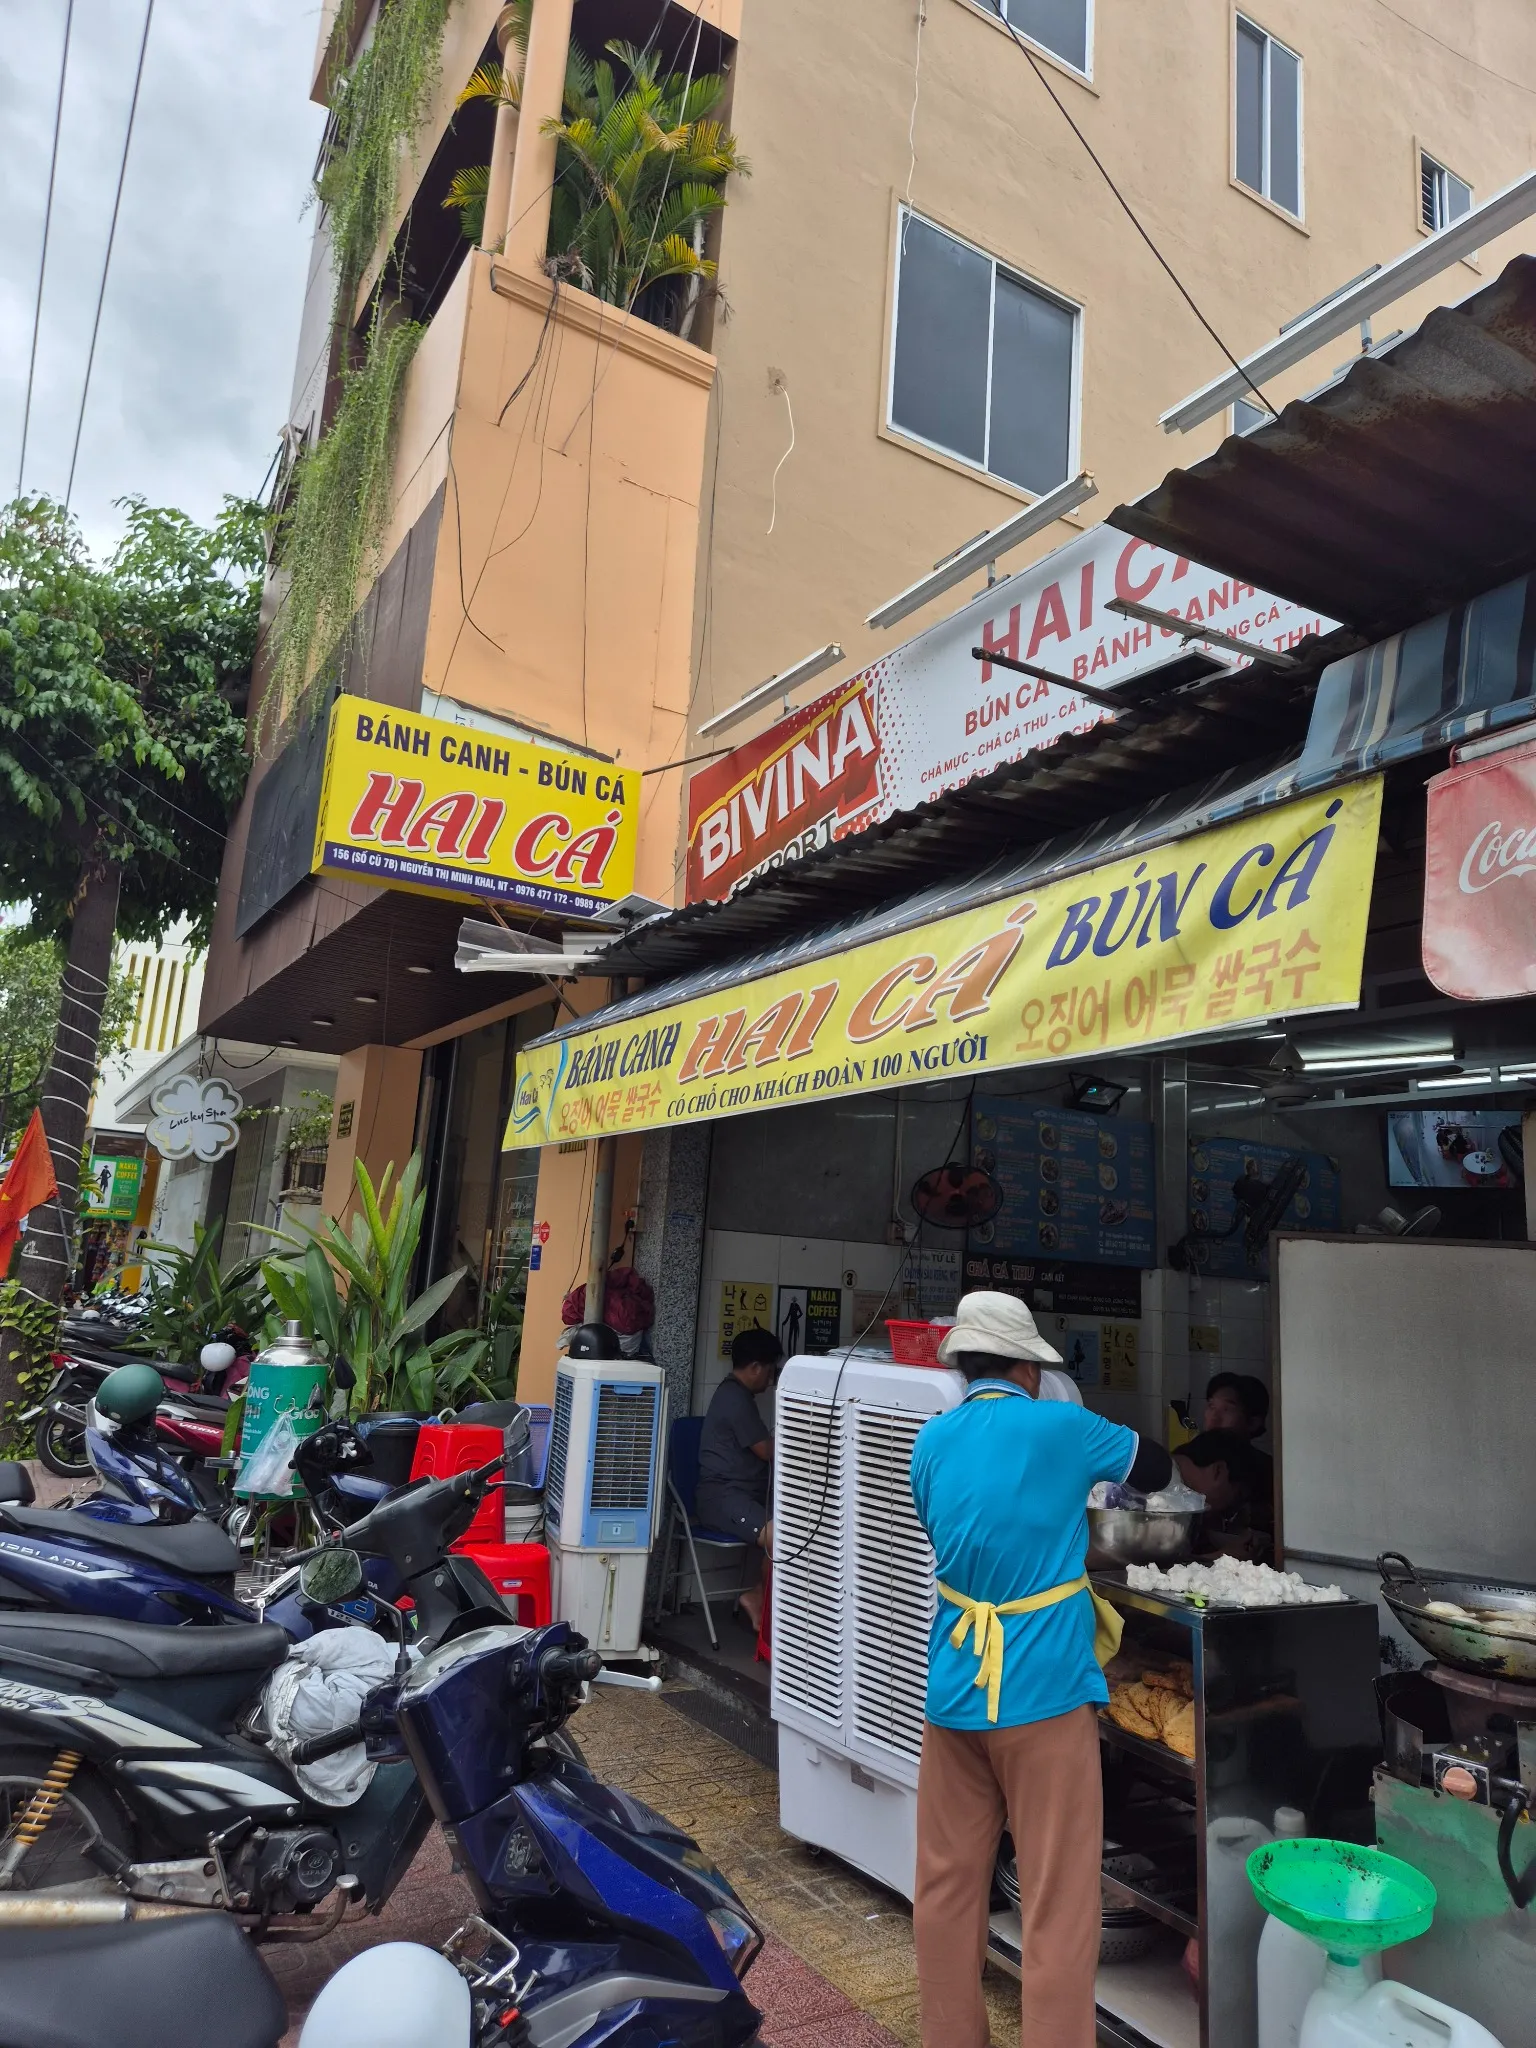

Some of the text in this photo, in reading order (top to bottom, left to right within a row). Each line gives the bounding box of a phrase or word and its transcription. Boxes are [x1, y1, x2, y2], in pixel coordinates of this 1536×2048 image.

[980, 560, 1095, 683] HAI
[921, 761, 942, 783] CHẢ
[944, 751, 969, 772] MỰC
[977, 732, 1002, 756] CHẢ
[1004, 724, 1021, 744] CÁ
[1024, 713, 1049, 735] THU
[1058, 697, 1077, 718] CÁ
[1254, 601, 1281, 628] CÁ
[965, 692, 1011, 736] BÚN
[1073, 622, 1152, 682] BÁNH
[356, 714, 430, 757] BÁNH
[439, 735, 510, 776] CANH
[518, 767, 529, 775] -
[538, 759, 587, 796] BÚN
[595, 774, 626, 805] CÁ
[700, 694, 878, 880] BIVINA
[349, 770, 623, 889] HAI CÁ
[333, 848, 349, 860] 156
[351, 850, 367, 864] (SỐ
[383, 857, 398, 872] 7B)
[400, 861, 433, 877] NGUYỄN
[435, 868, 449, 882] THỊ
[451, 871, 473, 885] MINH
[474, 875, 495, 891] KHAI,
[497, 880, 508, 892] NT
[516, 884, 535, 898] 0976
[536, 889, 551, 900] 477
[554, 892, 567, 904] 172
[575, 896, 594, 909] 0989
[1045, 798, 1344, 970] BÚN CÁ
[678, 900, 1037, 1086] HAI CÁ
[1016, 928, 1322, 1055] 오징어 어묵 쌀국수
[565, 1021, 682, 1090] BÁNH CANH
[667, 1093, 685, 1117] CÓ
[720, 1085, 750, 1108] CHO
[753, 1071, 810, 1102] KHÁCH
[812, 1057, 866, 1090] ĐOÀN
[871, 1053, 902, 1079] 100
[907, 1031, 989, 1073] NGƯỜI
[170, 1108, 226, 1129] Lucky Spa
[558, 1080, 662, 1135] 오징어 어묵 쌀국수
[116, 1171, 137, 1180] COFFEE
[807, 1304, 838, 1317] COFFEE
[810, 1290, 837, 1302] NAKIA
[967, 1258, 990, 1278] CHẢ
[992, 1260, 1009, 1280] CÁ
[1012, 1264, 1035, 1281] THU
[179, 1422, 219, 1434] VISION
